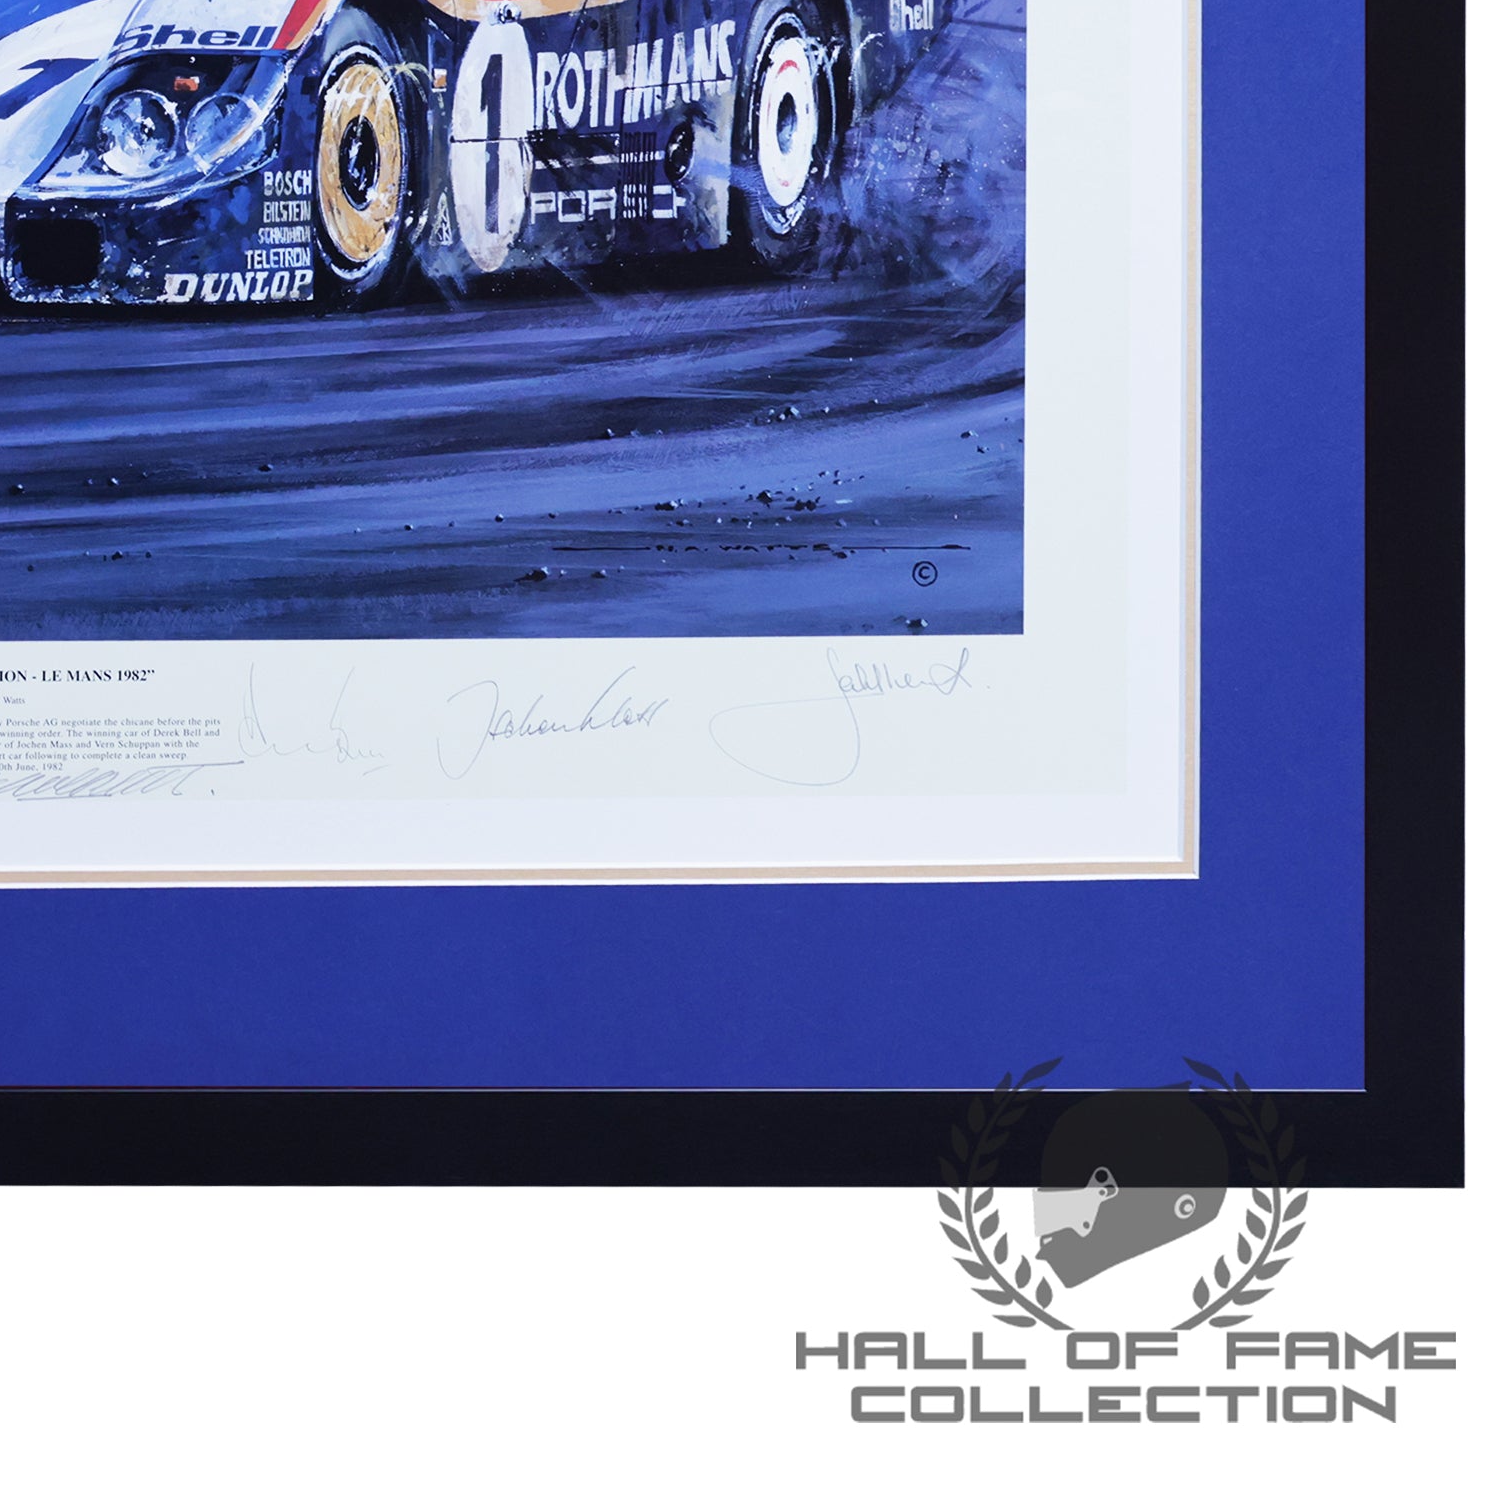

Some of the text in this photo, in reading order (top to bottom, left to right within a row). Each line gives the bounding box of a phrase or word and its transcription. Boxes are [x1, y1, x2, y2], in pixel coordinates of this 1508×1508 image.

[115, 24, 279, 49] Shell
[535, 20, 736, 129] ROTHMANS
[480, 53, 506, 234] 1
[263, 170, 312, 196] BOSCH
[263, 200, 311, 223] BILSTEIN
[245, 247, 311, 269] TELETRON
[161, 269, 314, 303] DUNLOP
[42, 670, 62, 682] LE
[67, 669, 112, 682] MANS
[3, 696, 25, 705] Watts
[6, 718, 40, 727] Porsche
[43, 718, 58, 727] AG
[61, 719, 101, 730] negotiate
[104, 718, 118, 727] the
[120, 718, 154, 727] chicane
[157, 718, 185, 727] before
[188, 718, 202, 727] the
[205, 718, 221, 729] pits
[0, 730, 34, 740] winning
[66, 729, 82, 738] The
[86, 729, 121, 740] winning
[141, 729, 150, 737] of
[153, 729, 179, 737] Derek
[183, 729, 201, 737] Bell
[204, 729, 220, 737] and
[4, 740, 14, 749] of
[17, 741, 47, 749] Jochen
[50, 740, 72, 749] Mass
[76, 740, 91, 749] and
[95, 740, 114, 749] Vern
[118, 740, 160, 751] Schuppan
[163, 740, 183, 748] with
[186, 740, 199, 748] the
[25, 751, 67, 762] following
[70, 752, 79, 760] to
[82, 751, 122, 762] complete
[133, 751, 156, 759] clean
[42, 762, 63, 771] 1982
